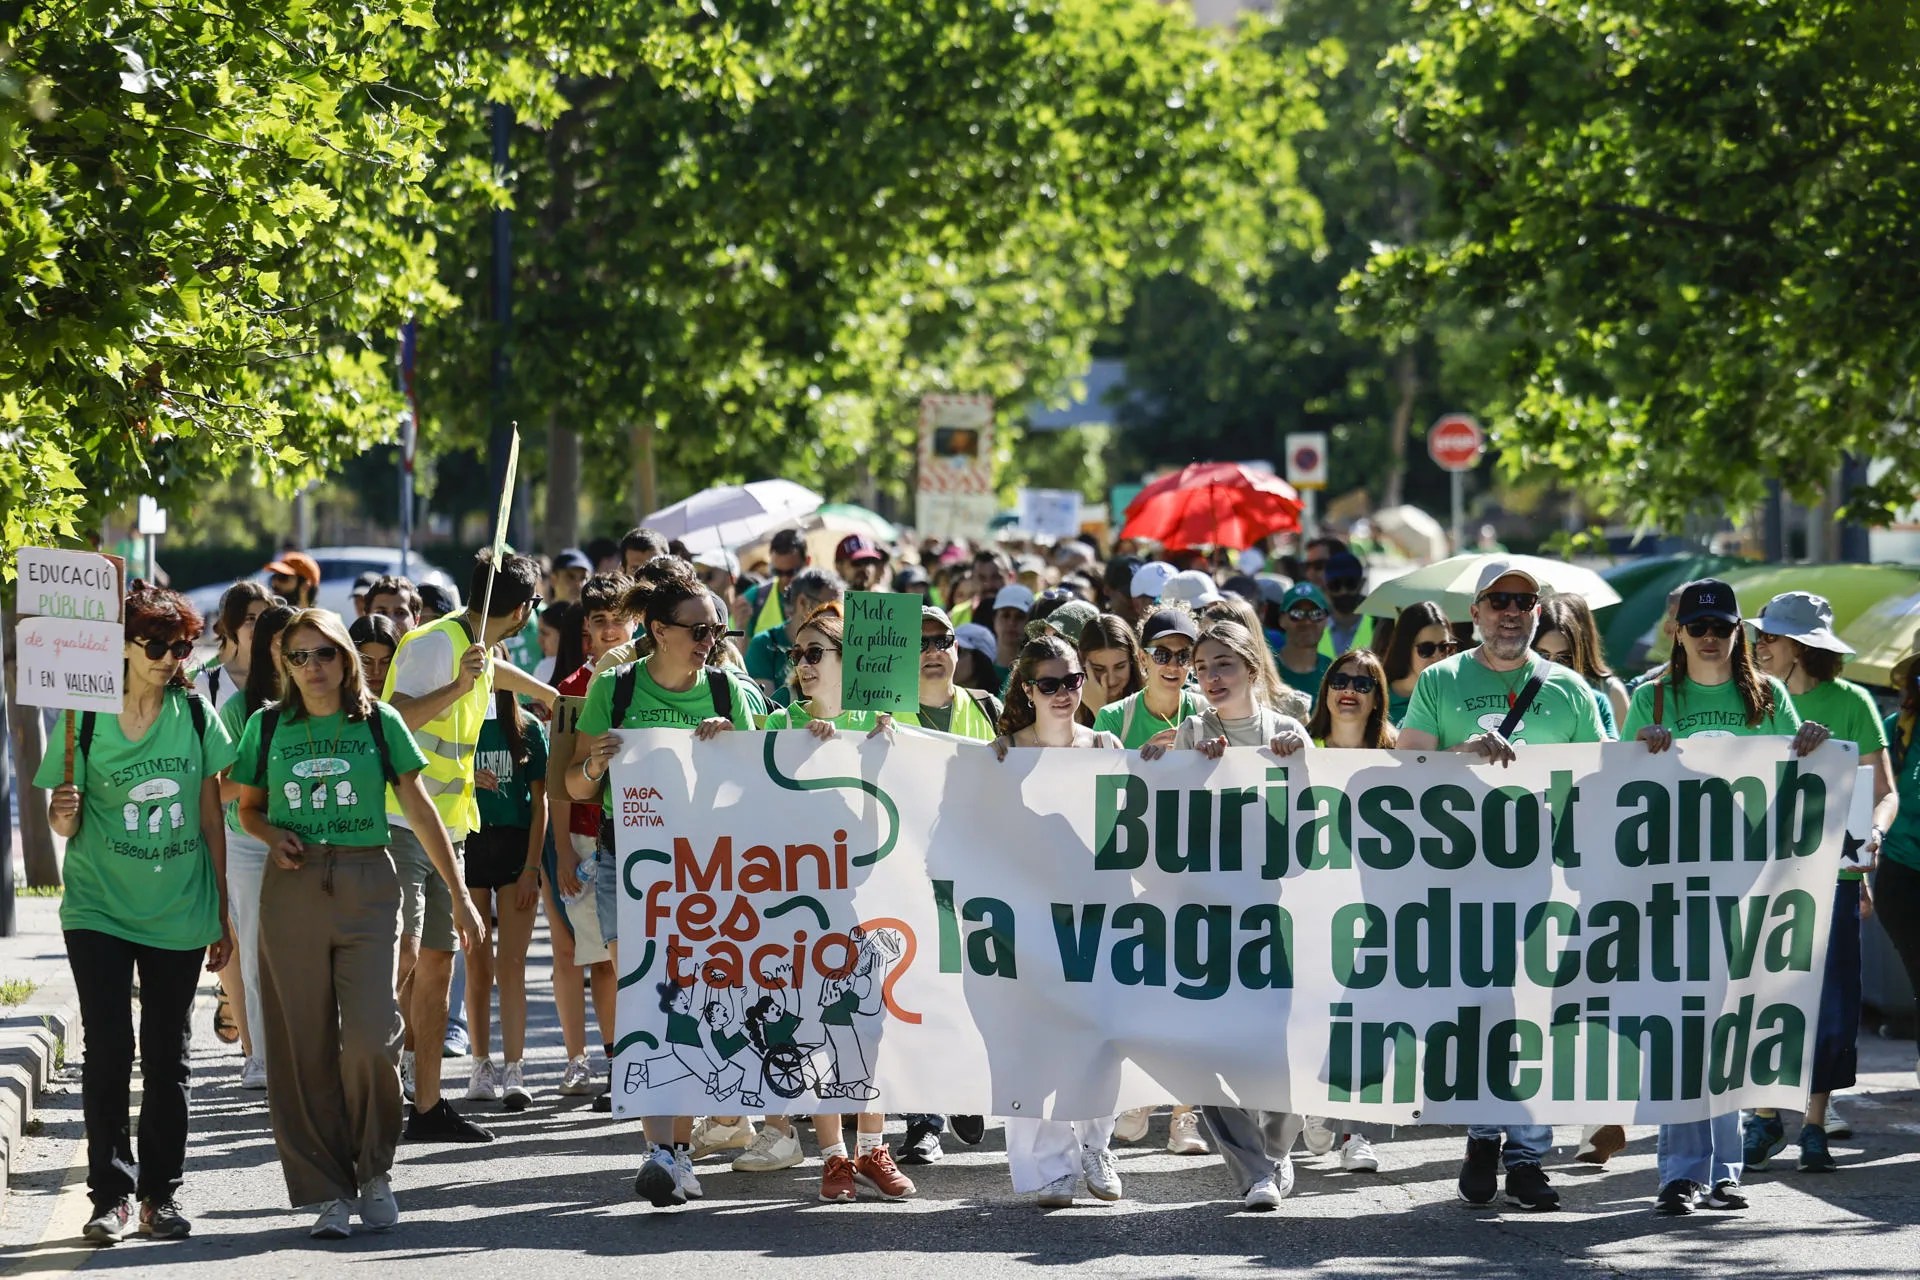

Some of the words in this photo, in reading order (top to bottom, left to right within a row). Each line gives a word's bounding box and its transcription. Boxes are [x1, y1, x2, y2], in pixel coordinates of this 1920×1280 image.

[29, 562, 111, 591] EDUCACIÓ
[25, 630, 44, 647] de
[847, 624, 863, 647] la
[867, 625, 908, 652] pública
[856, 653, 902, 673] Great
[40, 670, 55, 688] EN
[64, 670, 115, 694] VALENCIÀ
[640, 708, 706, 726] ESTIME
[281, 739, 367, 760] ESTIMEM
[110, 757, 189, 787] ESTIMEM
[623, 787, 663, 800] VAGA
[623, 815, 664, 827] CATIVA
[1095, 766, 1581, 880] Burjassot
[1615, 760, 1826, 867] amb
[673, 829, 848, 893] Mani
[645, 880, 761, 942] fes
[931, 880, 1018, 980] la
[1050, 902, 1294, 1000] vaga
[1331, 876, 1817, 990] educativa
[1327, 994, 1807, 1104] indefinida
